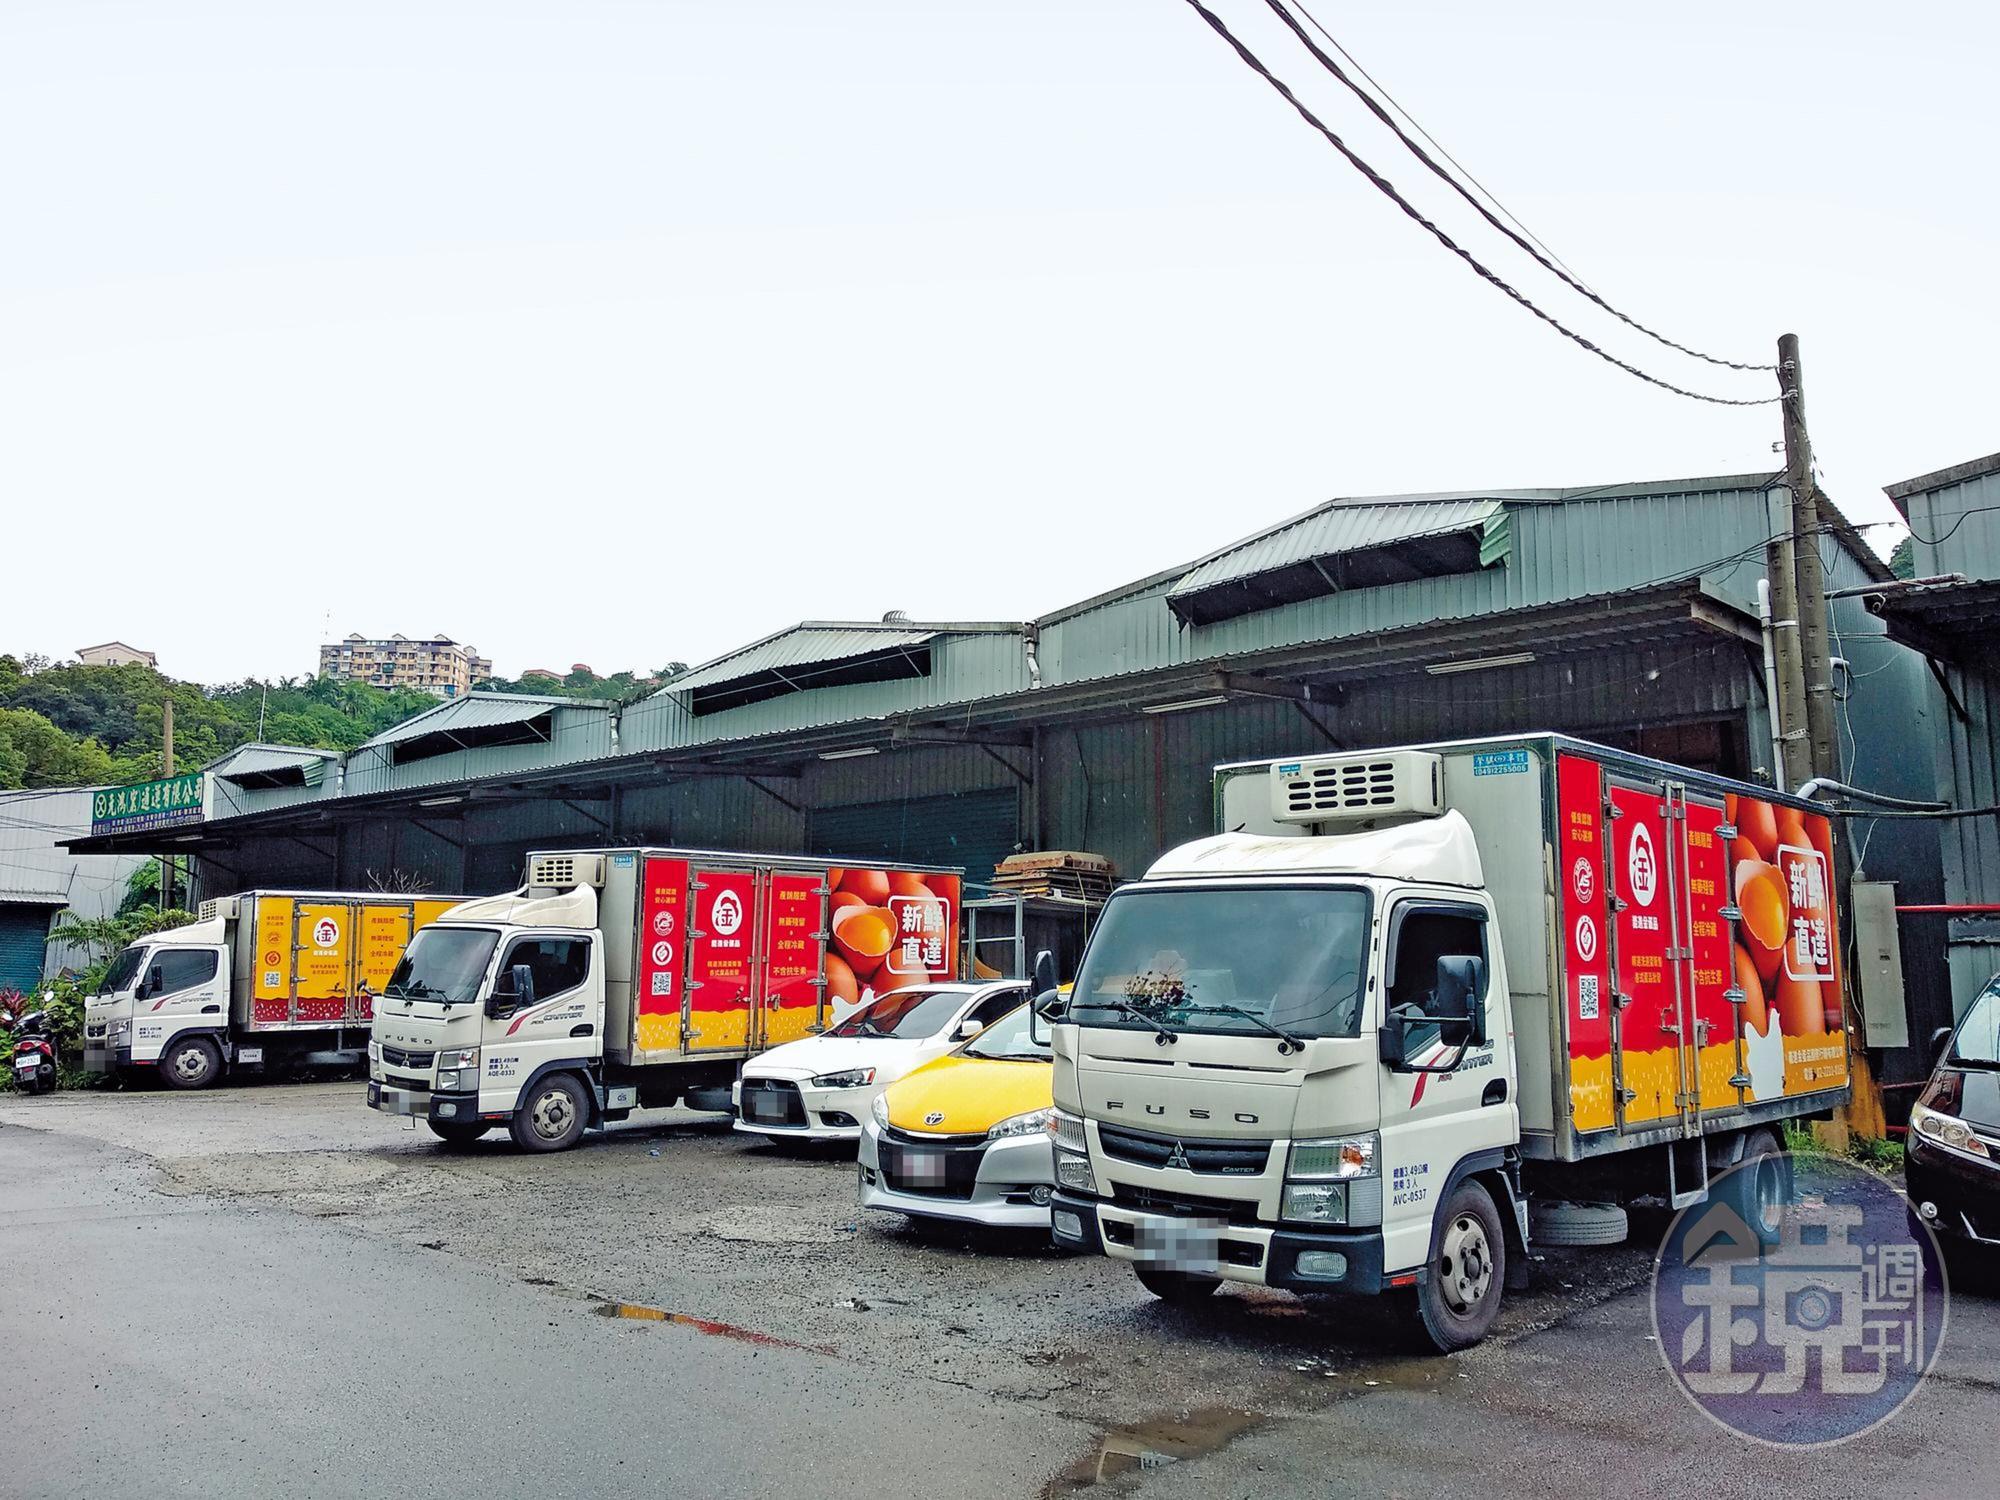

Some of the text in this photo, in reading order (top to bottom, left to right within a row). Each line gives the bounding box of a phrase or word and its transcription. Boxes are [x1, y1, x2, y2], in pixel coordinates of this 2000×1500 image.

[1790, 860, 1823, 911] 新鮮
[902, 904, 943, 932] 新鮮
[902, 936, 942, 966] 直達
[1794, 916, 1828, 965] 直達
[384, 1033, 433, 1045] FUSO
[1107, 1101, 1259, 1124] FUSO
[1222, 1165, 1255, 1174] CANTER
[1393, 1188, 1427, 1206] AVC-0537
